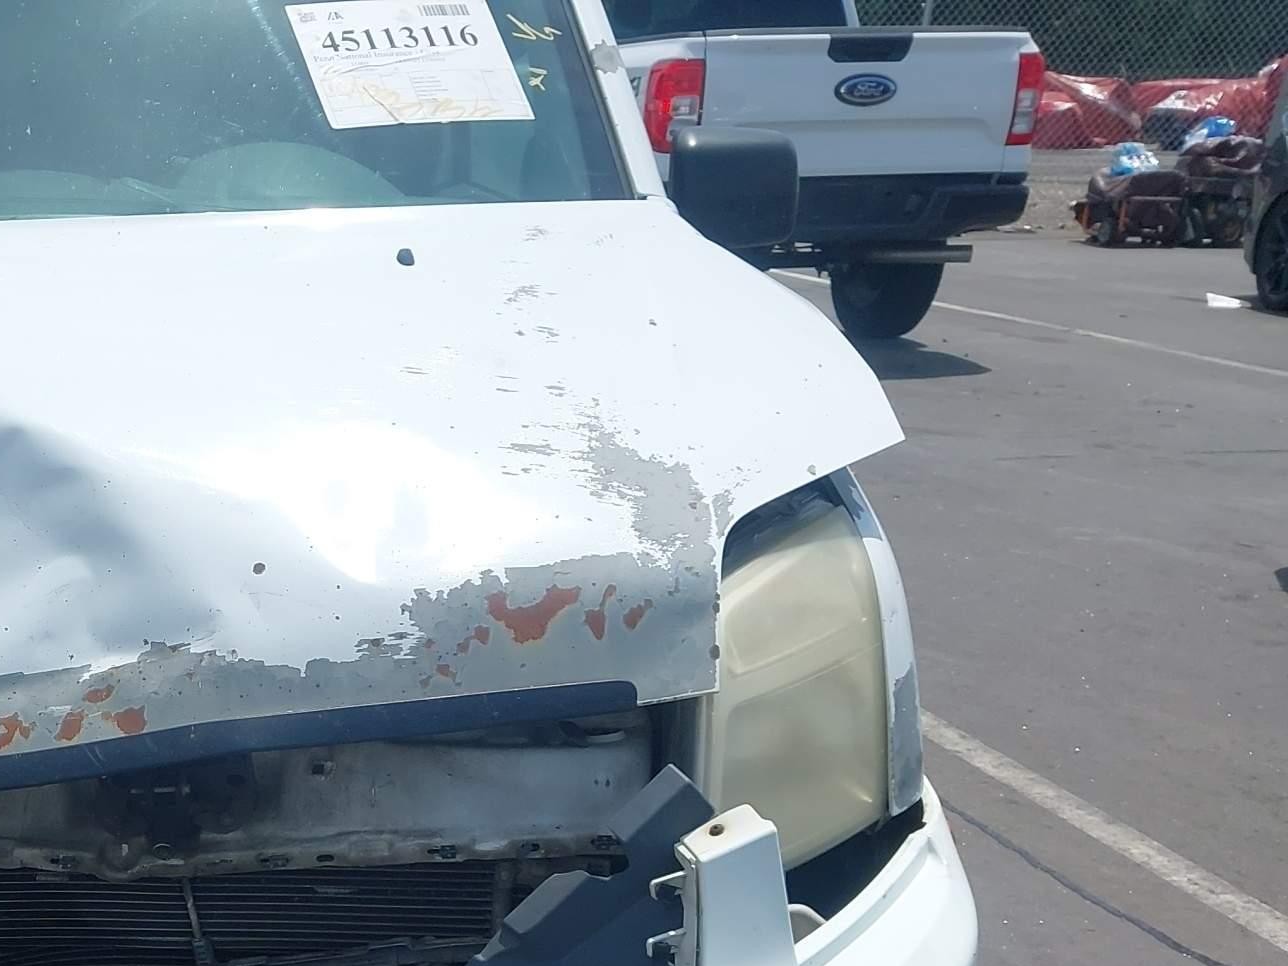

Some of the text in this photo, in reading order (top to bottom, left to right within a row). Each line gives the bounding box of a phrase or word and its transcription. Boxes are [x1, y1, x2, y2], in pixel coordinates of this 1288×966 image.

[322, 24, 478, 52] 45113116
[337, 52, 372, 60] National
[374, 50, 412, 58] Insurance
